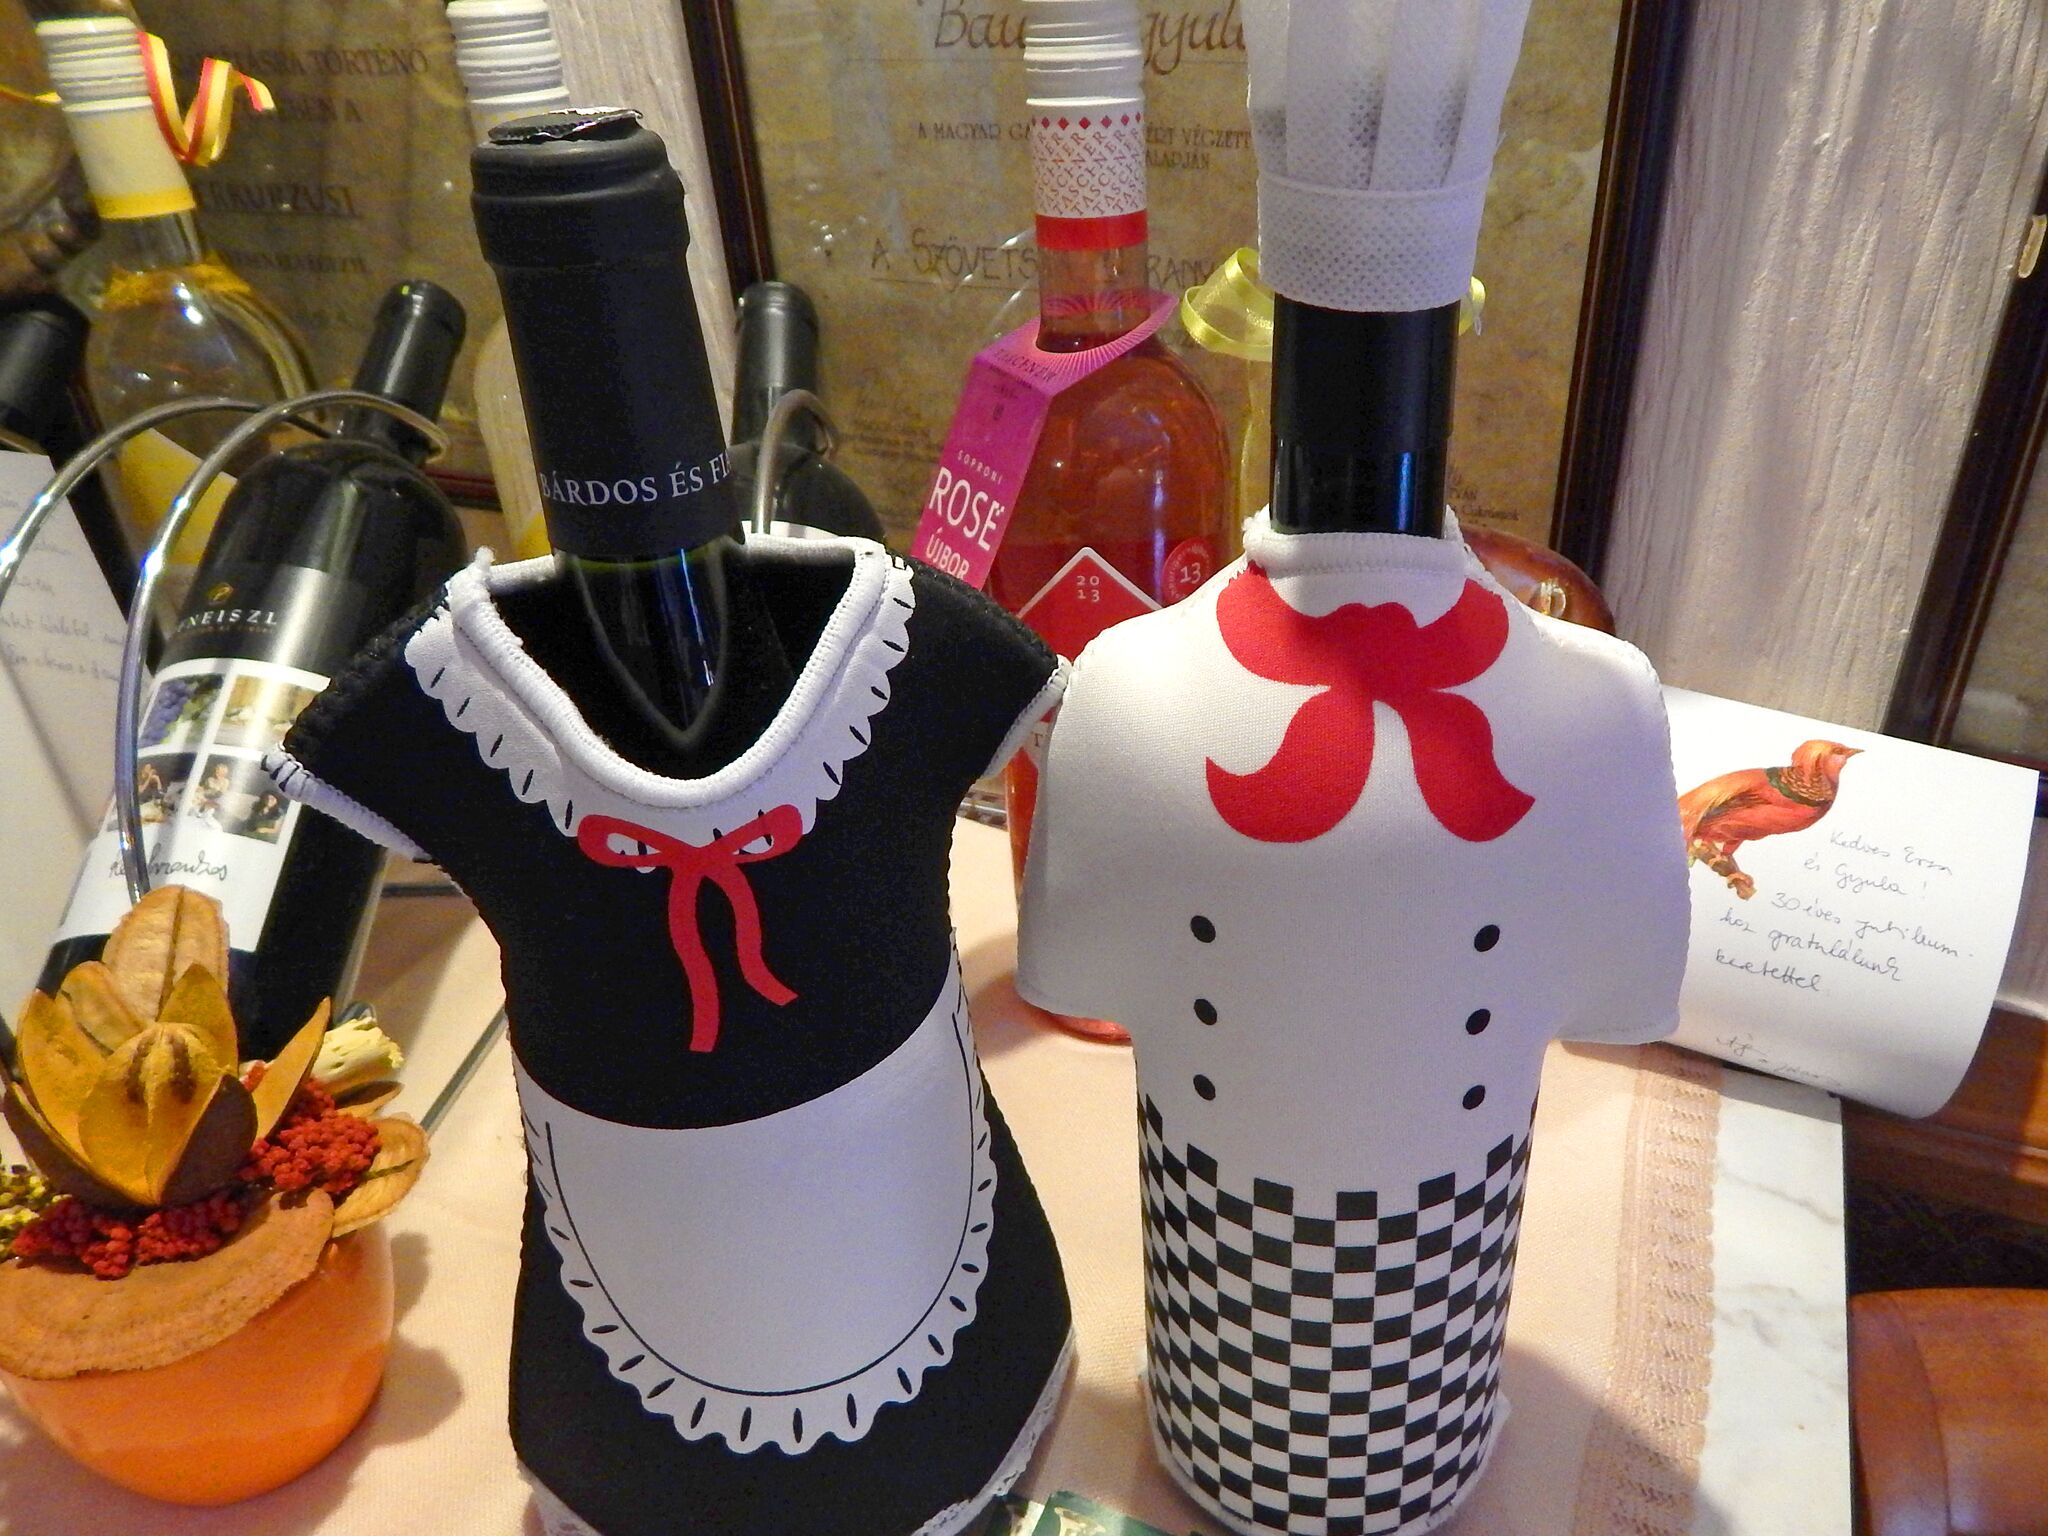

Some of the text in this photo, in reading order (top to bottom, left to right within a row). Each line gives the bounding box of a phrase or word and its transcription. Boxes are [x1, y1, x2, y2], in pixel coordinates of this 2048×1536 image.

[957, 450, 1003, 486] SOPRONI
[540, 470, 658, 505] BÁRDOS
[669, 461, 704, 498] ÉS
[1076, 575, 1100, 586] 20
[1179, 562, 1202, 585] 13
[1076, 590, 1100, 602] 13
[1804, 852, 1820, 871] és
[1771, 893, 1800, 911] 30
